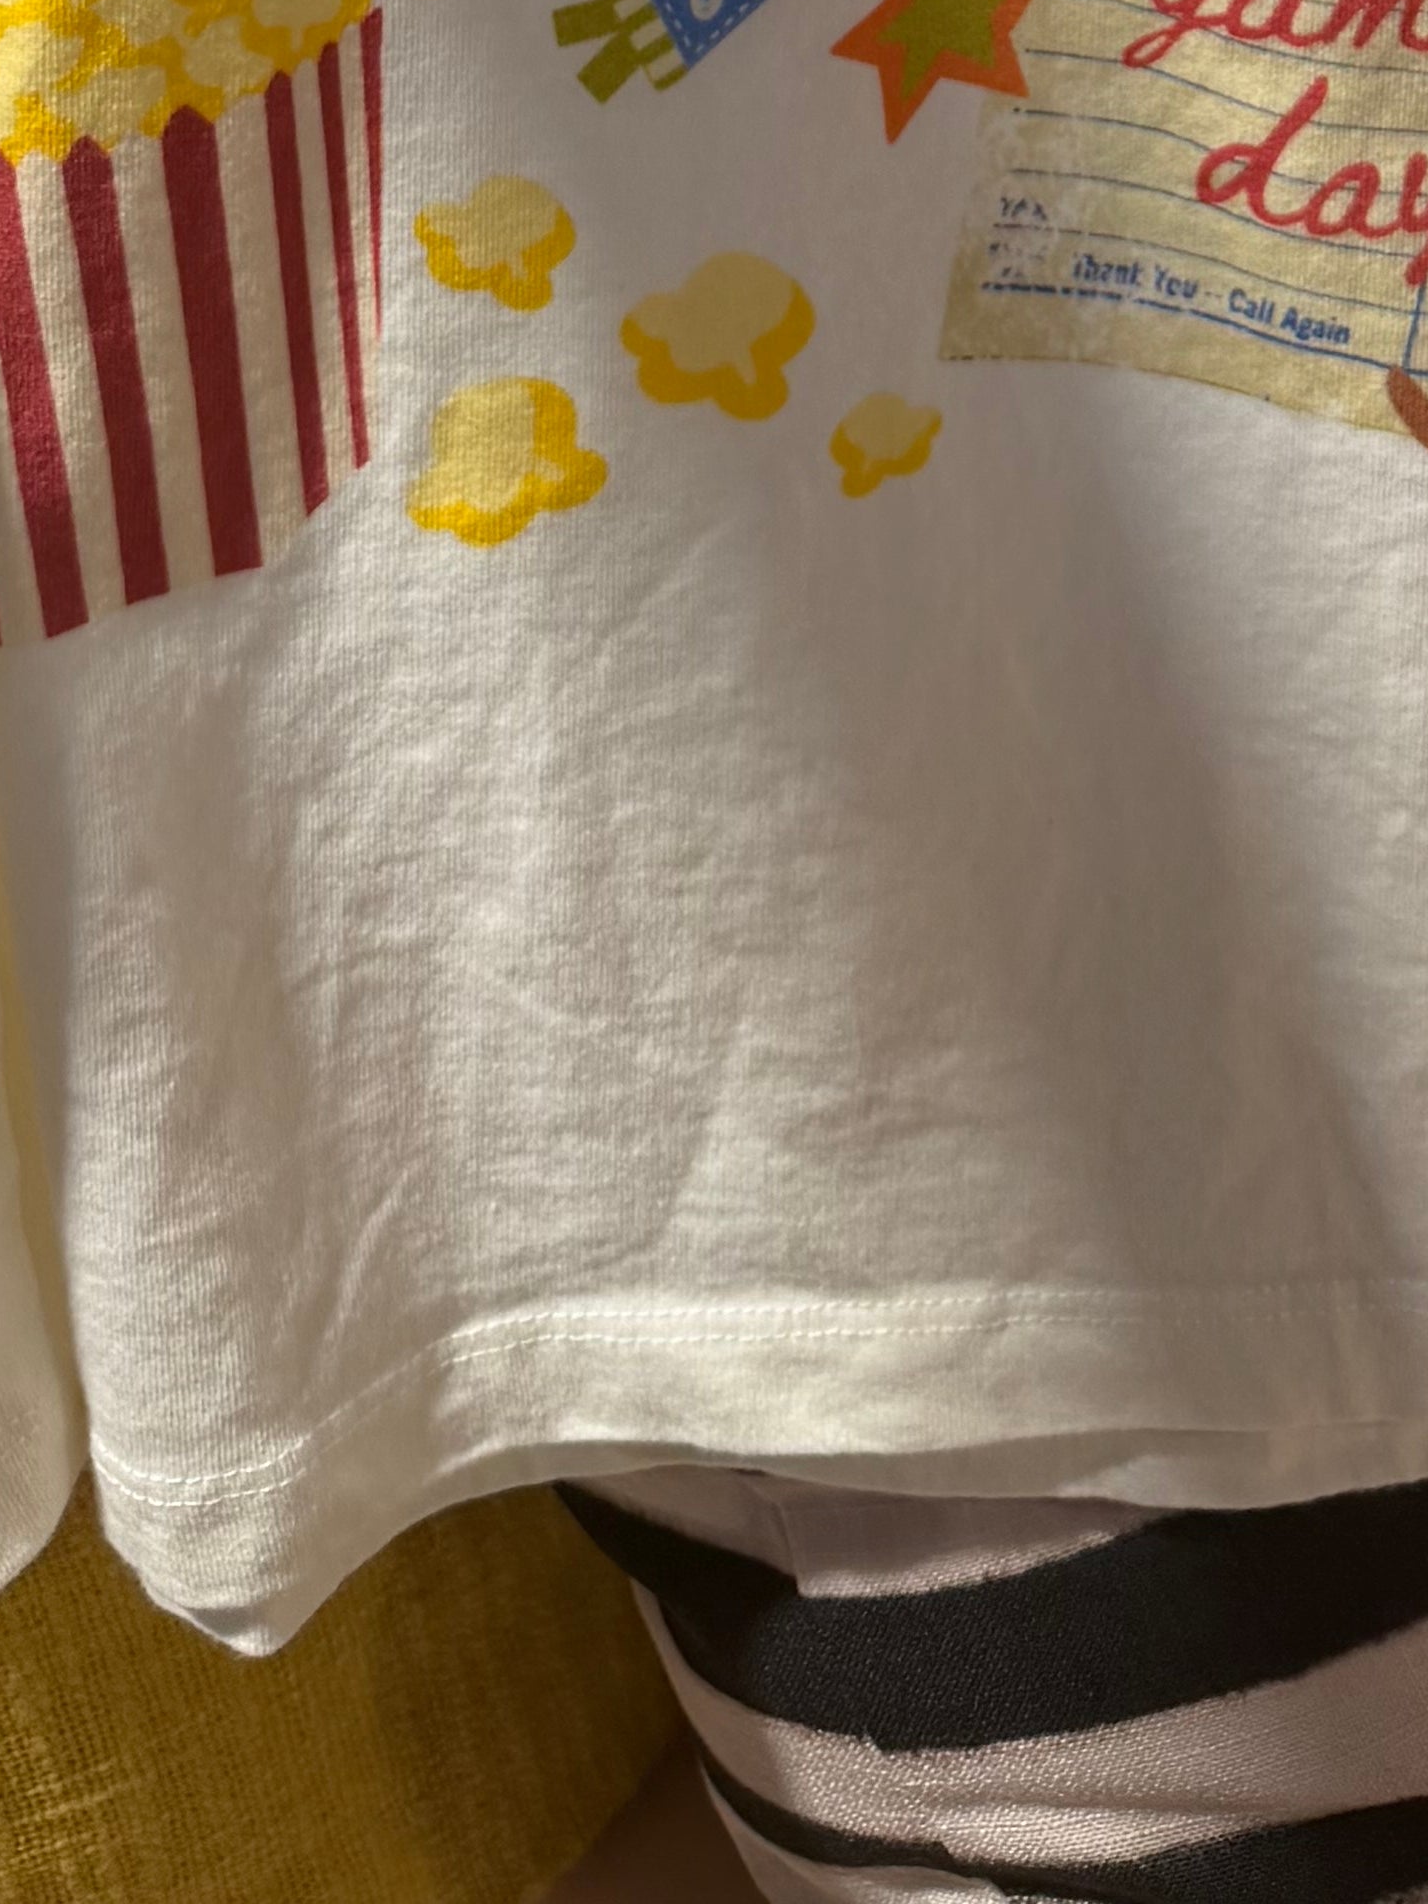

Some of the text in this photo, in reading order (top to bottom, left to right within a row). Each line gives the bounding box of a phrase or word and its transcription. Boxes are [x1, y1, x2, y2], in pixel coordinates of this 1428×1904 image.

[1073, 252, 1144, 287] Thank
[1154, 262, 1198, 300] You
[1228, 286, 1276, 324] Call
[1279, 307, 1351, 344] Again
